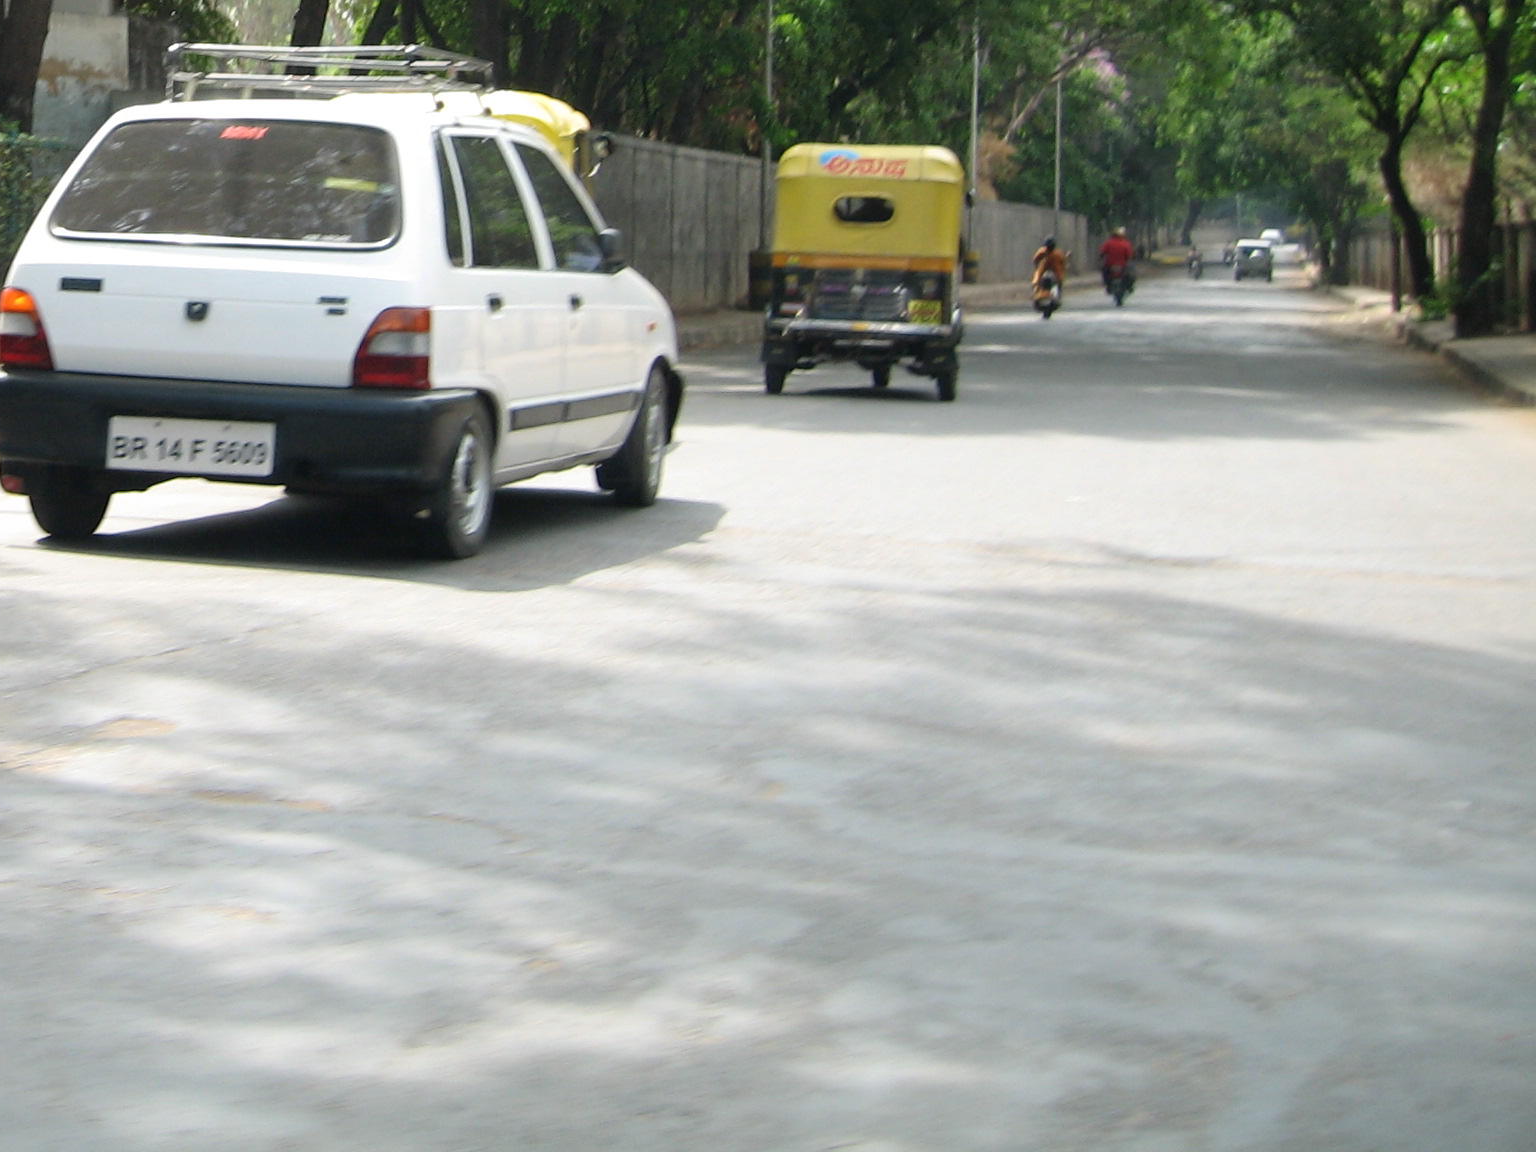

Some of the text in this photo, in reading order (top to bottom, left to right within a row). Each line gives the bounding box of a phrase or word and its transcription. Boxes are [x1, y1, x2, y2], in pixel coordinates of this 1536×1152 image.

[112, 436, 149, 460] BR
[155, 438, 184, 462] 14
[188, 439, 207, 463] F
